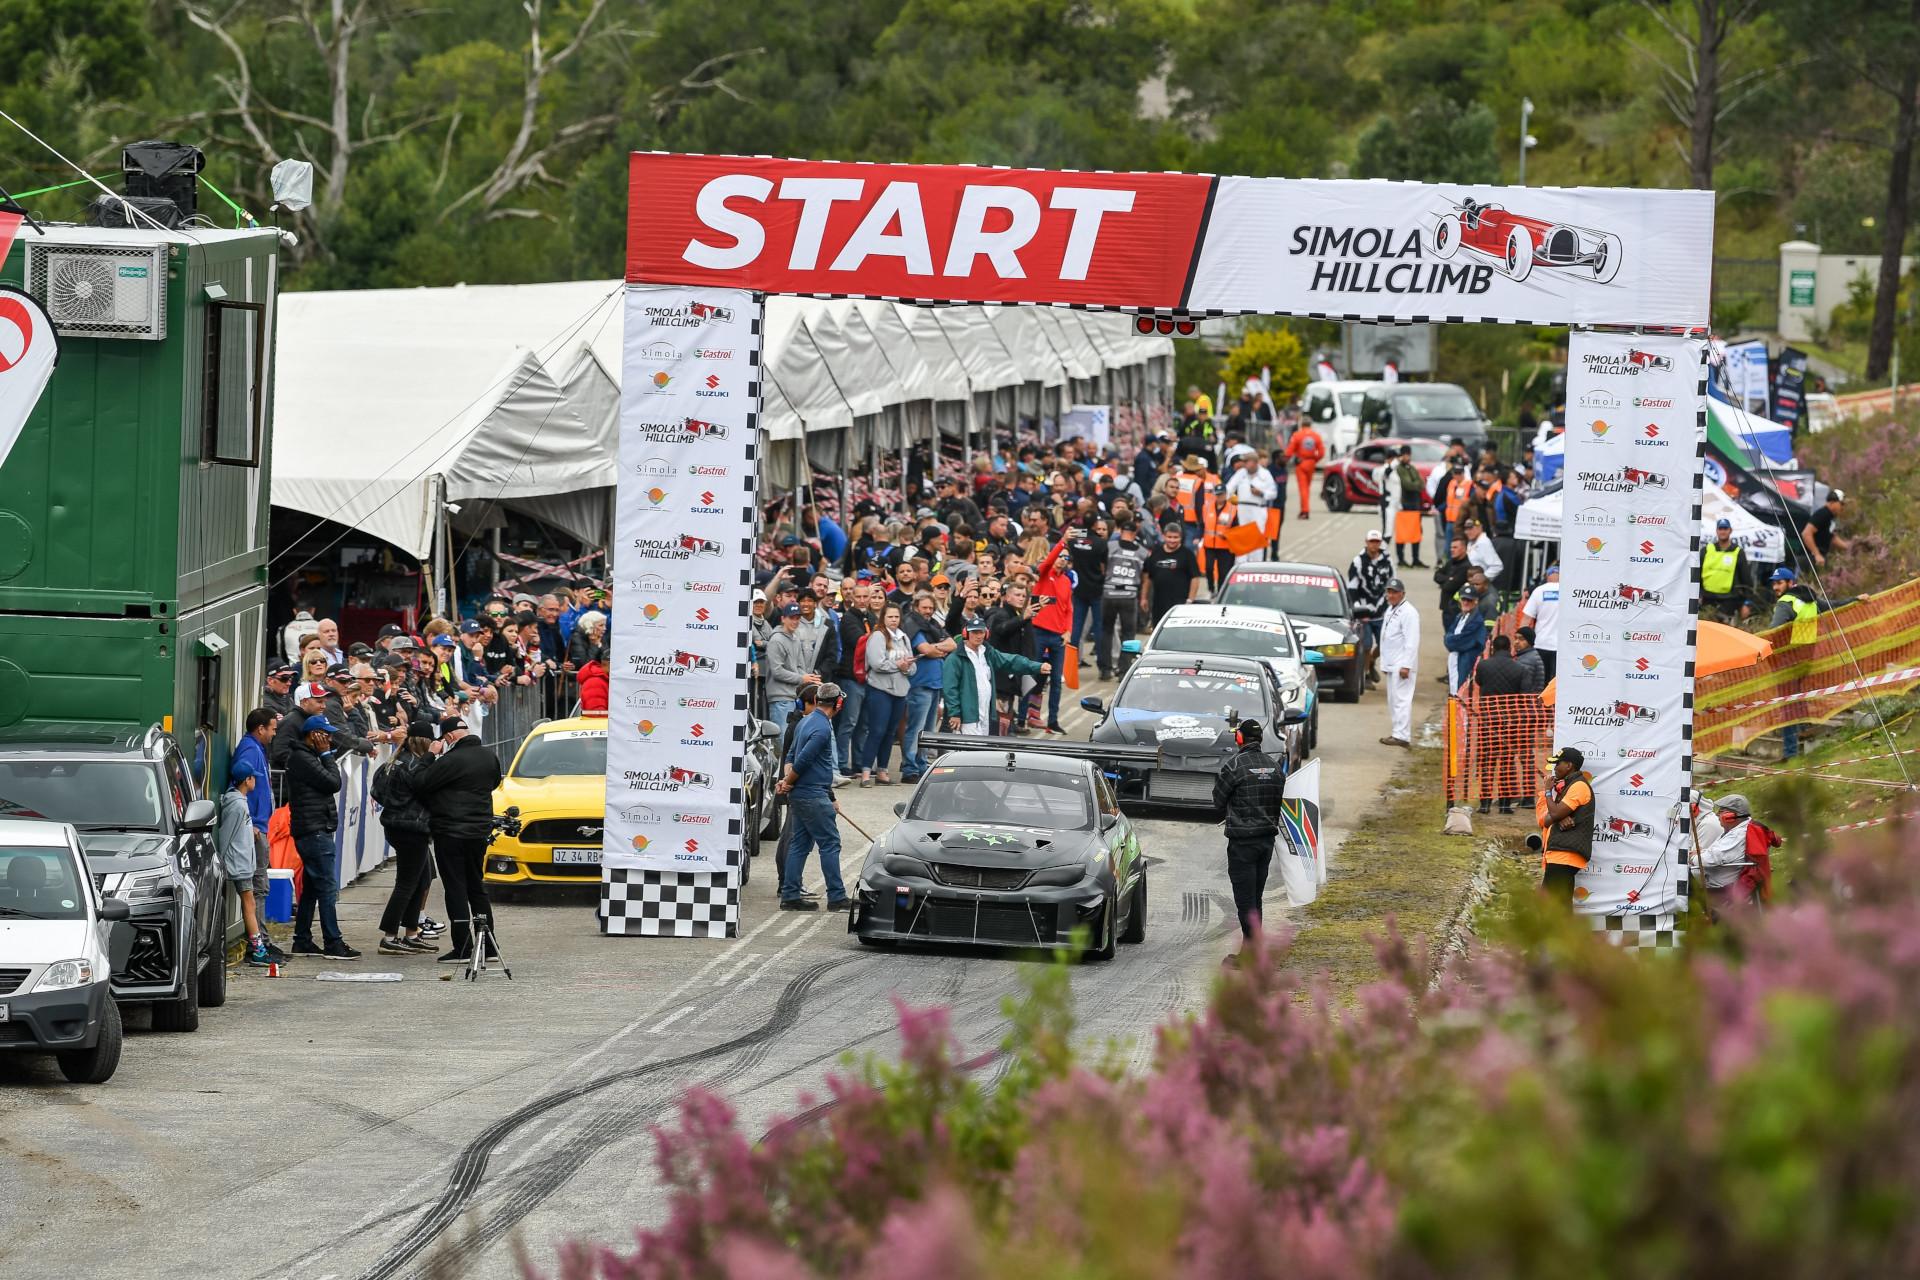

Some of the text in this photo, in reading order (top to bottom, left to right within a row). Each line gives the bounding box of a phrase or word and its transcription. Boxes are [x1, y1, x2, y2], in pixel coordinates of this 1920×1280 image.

[682, 174, 1136, 280] START
[1288, 225, 1422, 258] SIMOLA
[1310, 261, 1493, 294] HILLCLIMB
[644, 307, 681, 317] SIMOLA
[650, 317, 700, 328] HILLCLIMB
[641, 348, 682, 358] Simola
[703, 350, 732, 359] Castrol
[1582, 354, 1619, 365] SIMOLA
[1588, 364, 1639, 376] HILLCLIMB
[1580, 396, 1621, 407] Simola
[1642, 398, 1672, 408] Castrol
[639, 423, 676, 434] SIMOLA
[644, 433, 695, 444] HILLCLIMB
[636, 464, 677, 474] Simola
[698, 466, 726, 476] Castrol
[1577, 472, 1614, 482] SIMOLA
[1583, 482, 1634, 493] HILLCLIMB
[1574, 513, 1616, 523] Simola
[1637, 515, 1666, 525] Castrol
[634, 539, 670, 550] SIMOLA
[640, 549, 690, 560] HILLCLIMB
[1113, 566, 1136, 577] 505
[1236, 573, 1320, 586] MITSUBISHI
[631, 580, 672, 591] Simola
[692, 583, 722, 592] Castrol
[1572, 589, 1609, 599] SIMOLA
[1578, 599, 1628, 610] HILLCLIMB
[1183, 618, 1268, 630] BRIDGESTONE
[1569, 630, 1611, 641] Simola
[1632, 632, 1662, 642] Castrol
[629, 655, 665, 666] SIMOLA
[634, 665, 684, 676] HILLCLIMB
[1134, 666, 1180, 675] FORMULA
[1198, 670, 1259, 682] MOTORSPORT
[626, 696, 667, 706] Simola
[687, 699, 716, 709] Castrol
[1568, 706, 1605, 716] SIMOLA
[1573, 716, 1625, 727] HILLCLIMB
[1627, 750, 1656, 758] Castrol
[623, 770, 660, 781] SIMOLA
[629, 780, 679, 792] HILLCLIMB
[620, 811, 661, 822] Simola
[681, 814, 711, 824] Castrol
[1592, 832, 1619, 842] CLIMB
[556, 851, 598, 862] JZ 34 RB
[1624, 864, 1652, 874] Castrol
